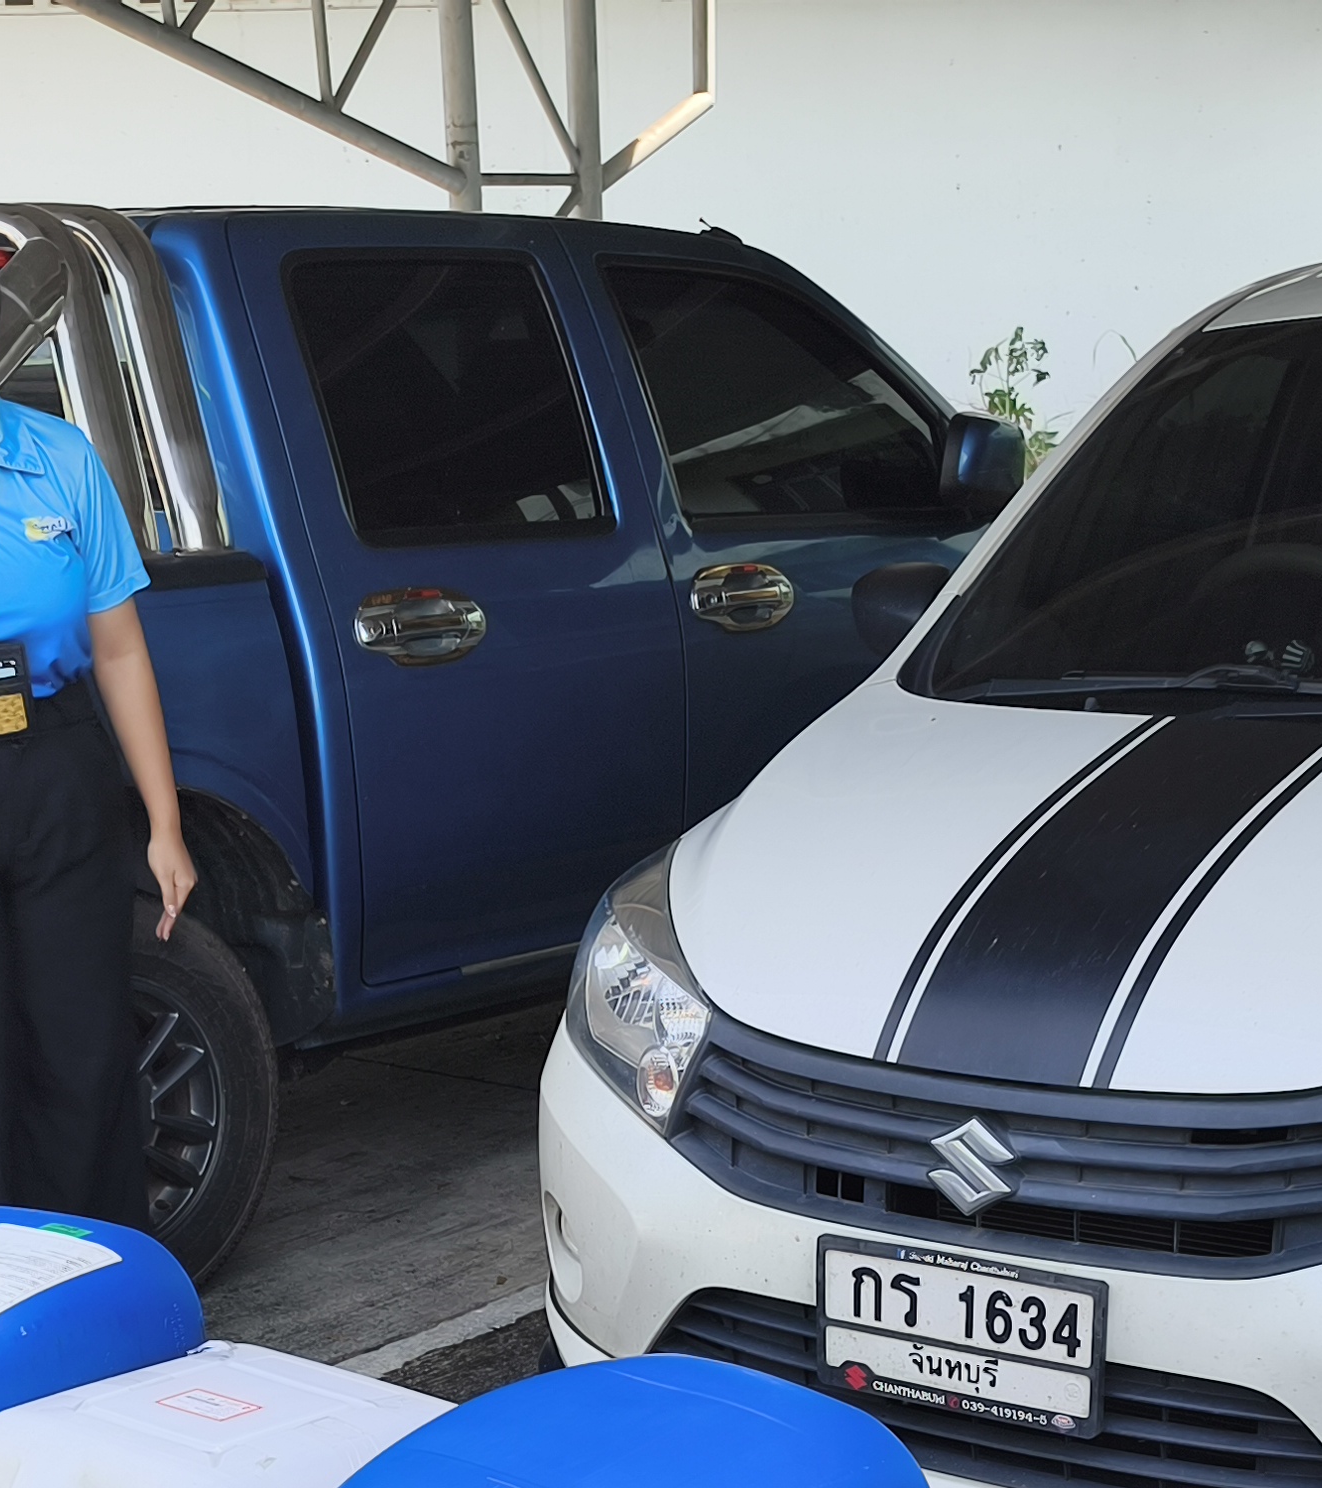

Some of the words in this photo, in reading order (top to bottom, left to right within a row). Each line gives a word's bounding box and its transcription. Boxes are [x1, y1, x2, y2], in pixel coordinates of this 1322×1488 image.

[851, 1266, 921, 1328] กร
[958, 1284, 1082, 1358] 1634
[908, 1343, 999, 1393] จันทบุรี
